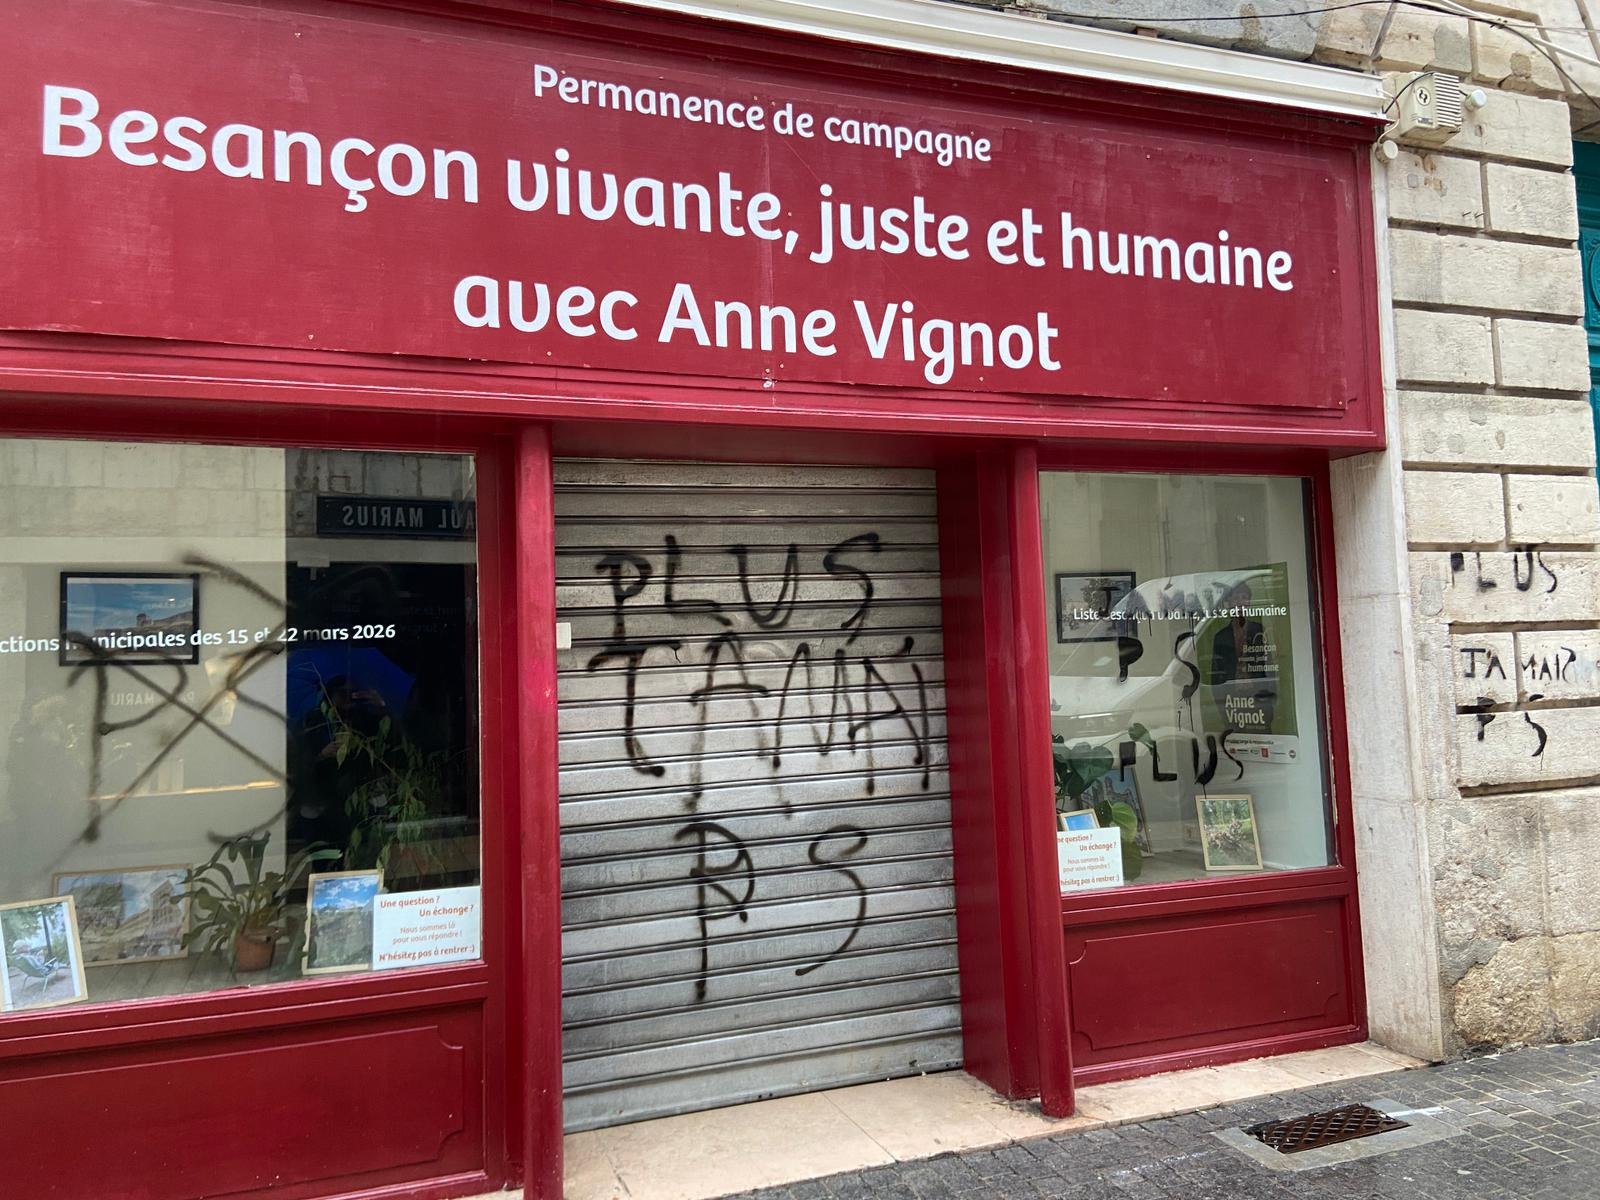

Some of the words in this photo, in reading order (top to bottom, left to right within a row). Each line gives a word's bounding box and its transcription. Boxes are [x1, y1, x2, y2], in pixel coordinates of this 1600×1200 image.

[533, 63, 766, 131] Permanence
[773, 102, 815, 138] de
[823, 116, 992, 167] campagne
[42, 84, 479, 213] Besançon
[507, 147, 799, 255] vivante,
[809, 183, 970, 264] juste
[986, 207, 1046, 268] et
[1061, 211, 1294, 292] humaine
[453, 275, 639, 341] avec
[657, 282, 838, 357] Anne
[852, 299, 1062, 385] Vignot
[1450, 545, 1558, 593] PLUS
[596, 532, 881, 645] PLUS
[1073, 607, 1100, 620] Liste
[1229, 605, 1241, 618] et
[1242, 604, 1287, 617] humaine
[65, 631, 186, 651] nicipales
[190, 629, 223, 646] des
[227, 629, 248, 644] 15
[277, 627, 299, 642] 22
[303, 628, 349, 641] mars
[352, 624, 396, 640] 2026
[1117, 631, 1200, 701] PS
[1225, 694, 1255, 709] Anne
[1226, 708, 1266, 729] Vignot
[1119, 729, 1244, 786] PLUS
[380, 900, 397, 909] Une
[398, 896, 435, 909] question
[419, 909, 431, 917] Un
[392, 937, 409, 945] pour
[440, 945, 469, 955] rentrer
